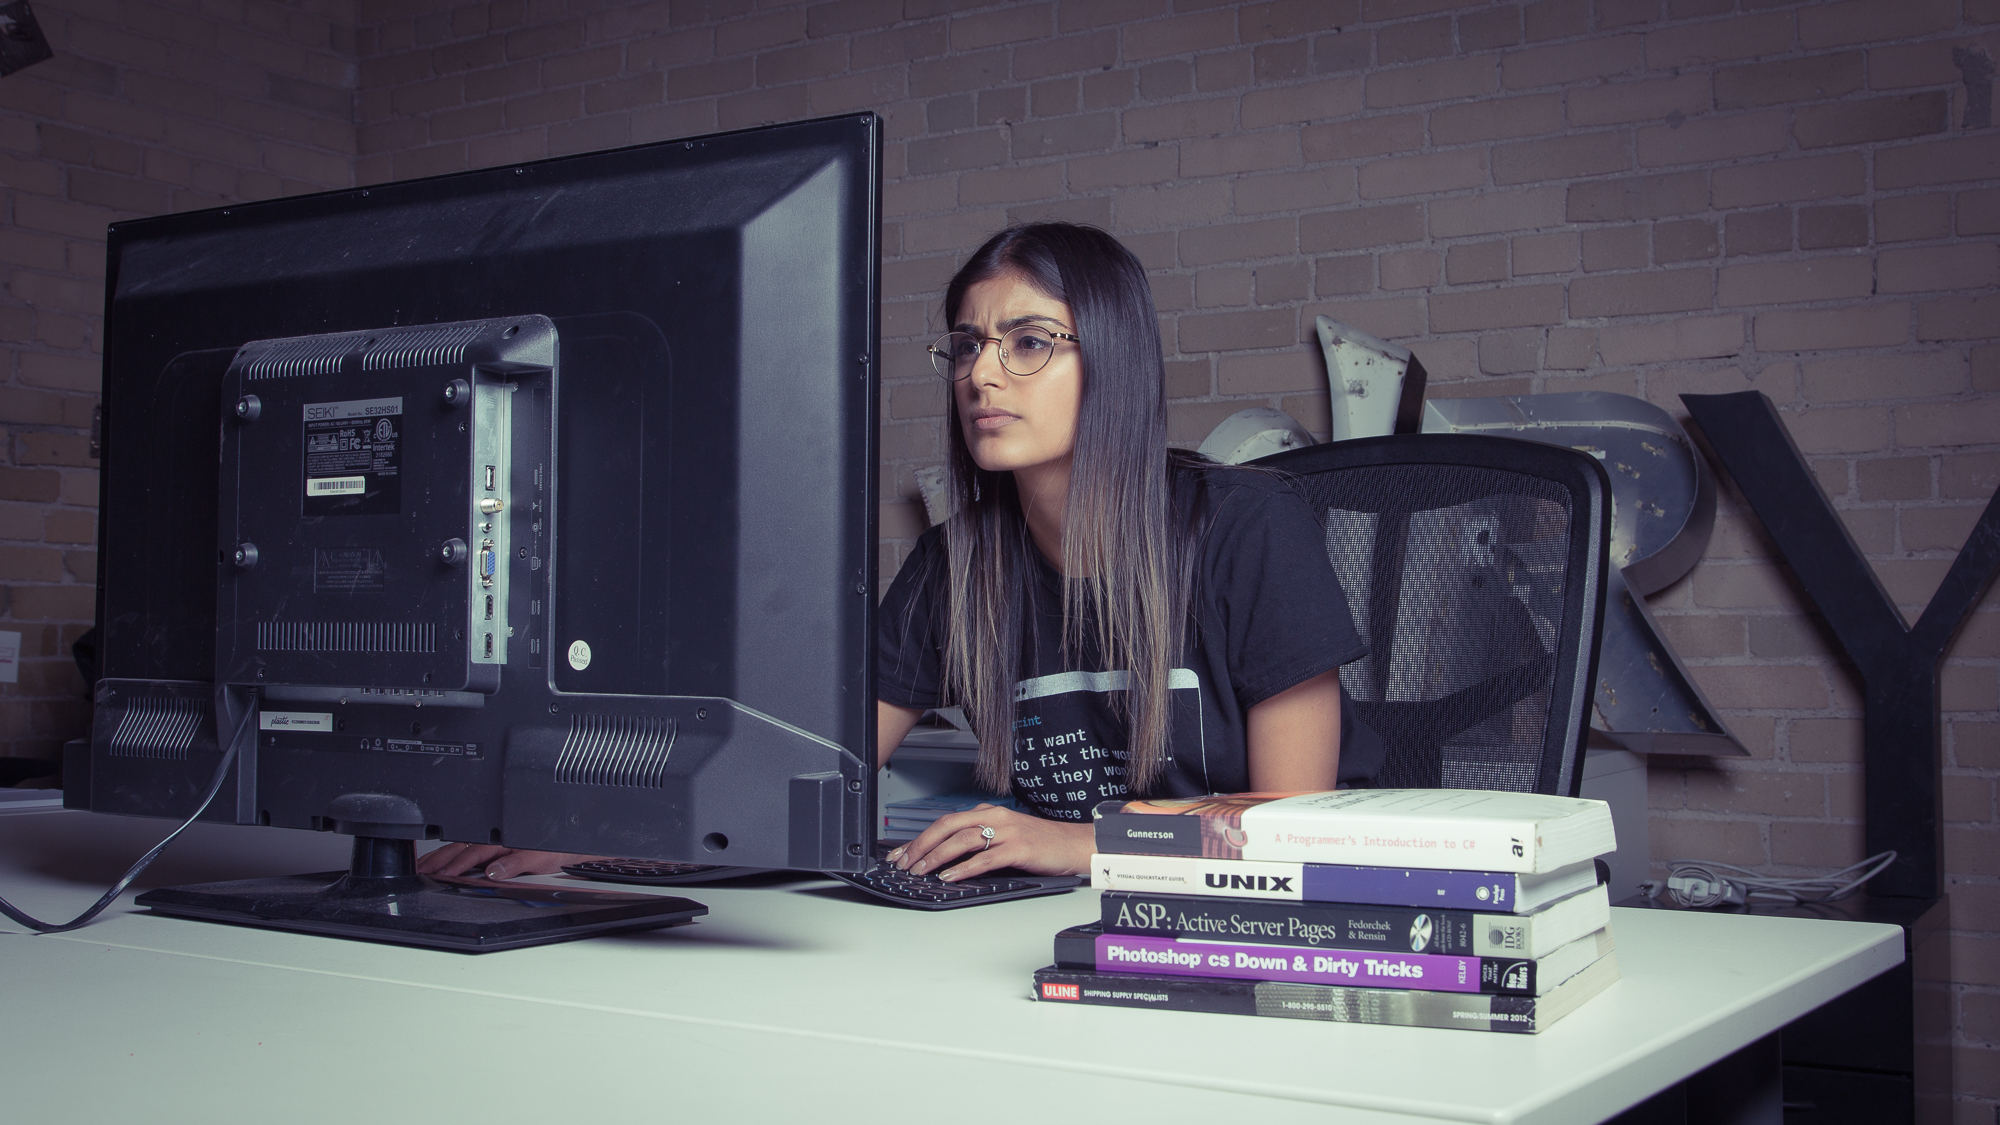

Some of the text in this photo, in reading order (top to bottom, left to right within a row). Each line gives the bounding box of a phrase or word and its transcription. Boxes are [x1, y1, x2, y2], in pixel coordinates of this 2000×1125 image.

[308, 407, 335, 419] SEIKI
[365, 406, 398, 415] SE32HS01
[340, 429, 355, 437] RoHS
[373, 443, 395, 451] Intertek
[570, 654, 588, 666] Passed
[270, 715, 290, 728] plastic
[1044, 728, 1087, 748] want
[1014, 759, 1030, 773] to
[1039, 753, 1069, 769] fix
[1079, 745, 1110, 761] the
[1017, 774, 1044, 789] But
[1052, 768, 1093, 785] they
[1066, 789, 1087, 802] me
[1098, 782, 1128, 797] the
[1126, 828, 1175, 840] Gunnerson
[1274, 833, 1476, 850] A Programmer's Introduction to C#
[1204, 873, 1295, 893] UNIX
[1115, 901, 1337, 945] ASP: Active Server Pages
[1347, 919, 1392, 932] Fedorchek
[1348, 930, 1387, 942] & Rensin
[1459, 923, 1467, 948] 8042-6
[1504, 926, 1515, 950] IDG
[1107, 945, 1201, 968] Photoshop
[1234, 952, 1288, 971] Down
[1292, 955, 1309, 972] &
[1313, 956, 1359, 977] Dirty
[1364, 958, 1424, 979] Tricks
[1458, 959, 1467, 985] KELBY
[1516, 966, 1528, 990] Riders
[1506, 973, 1518, 989] New
[1044, 985, 1078, 998] ULINE
[1083, 989, 1169, 1002] SHIPPING SUPPLY SPECIALISTS
[1281, 1001, 1333, 1011] 1-800-295-5510
[1452, 1010, 1528, 1022] SPRING/SUMMER 2012
